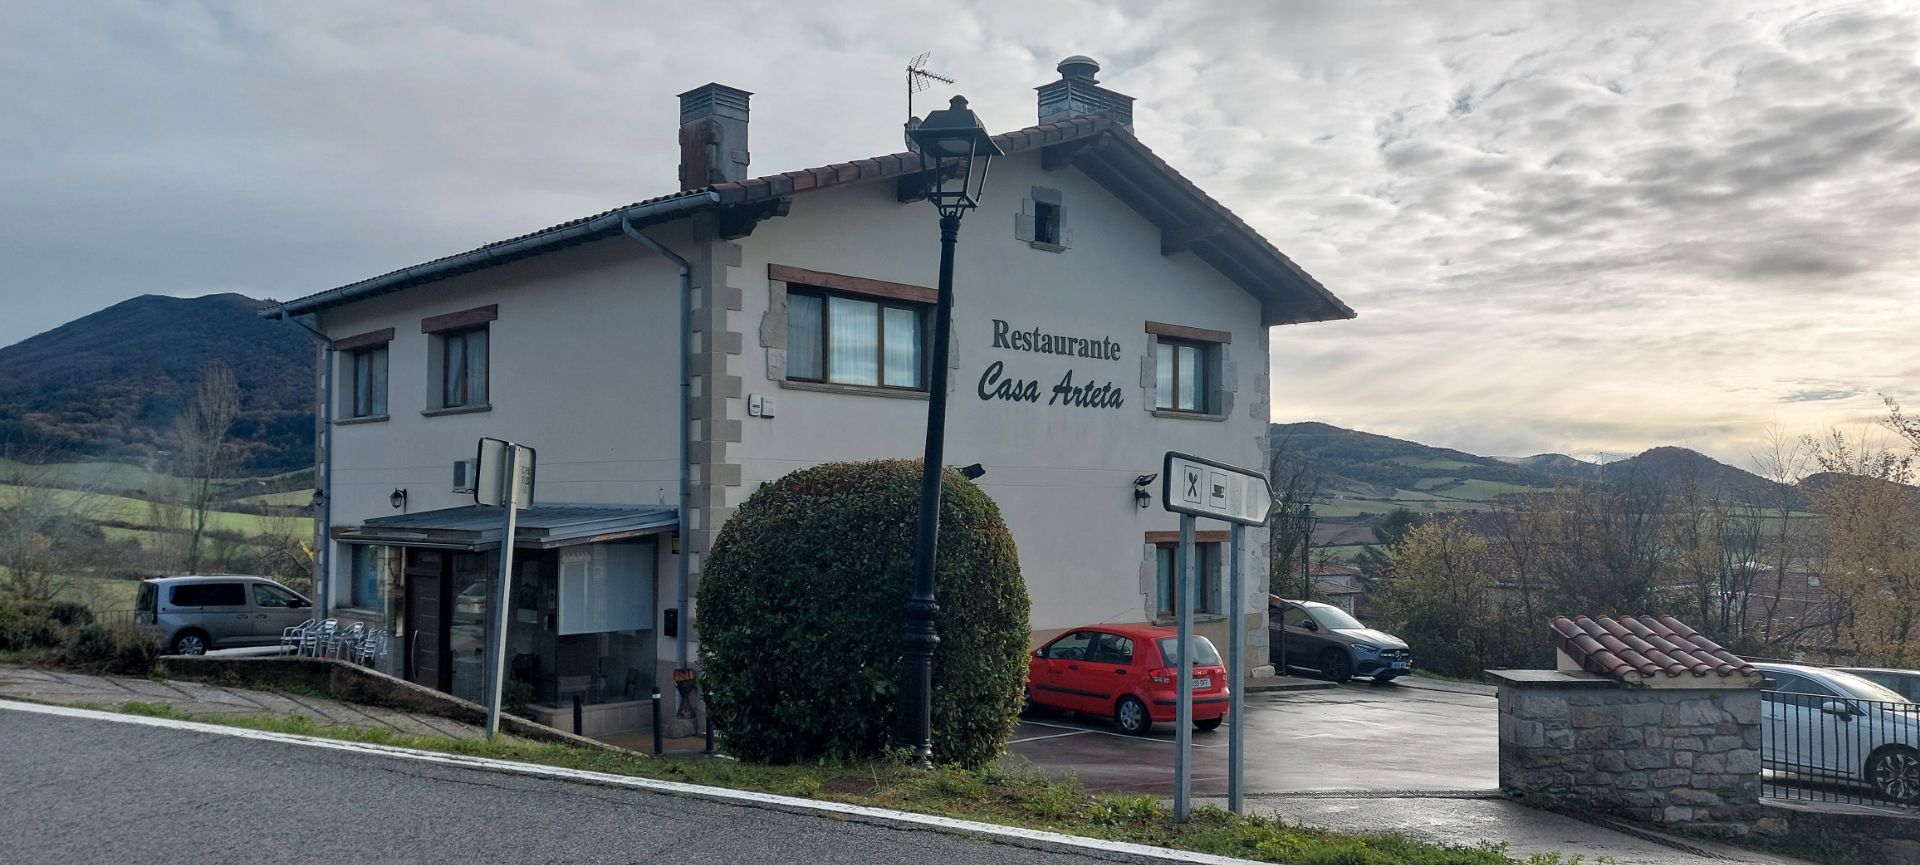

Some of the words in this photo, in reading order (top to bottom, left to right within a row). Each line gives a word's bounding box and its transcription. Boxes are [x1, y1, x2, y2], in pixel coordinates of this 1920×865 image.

[992, 318, 1121, 361] Restaurante
[978, 360, 1041, 403] Casa
[1049, 369, 1124, 409] Arteta
